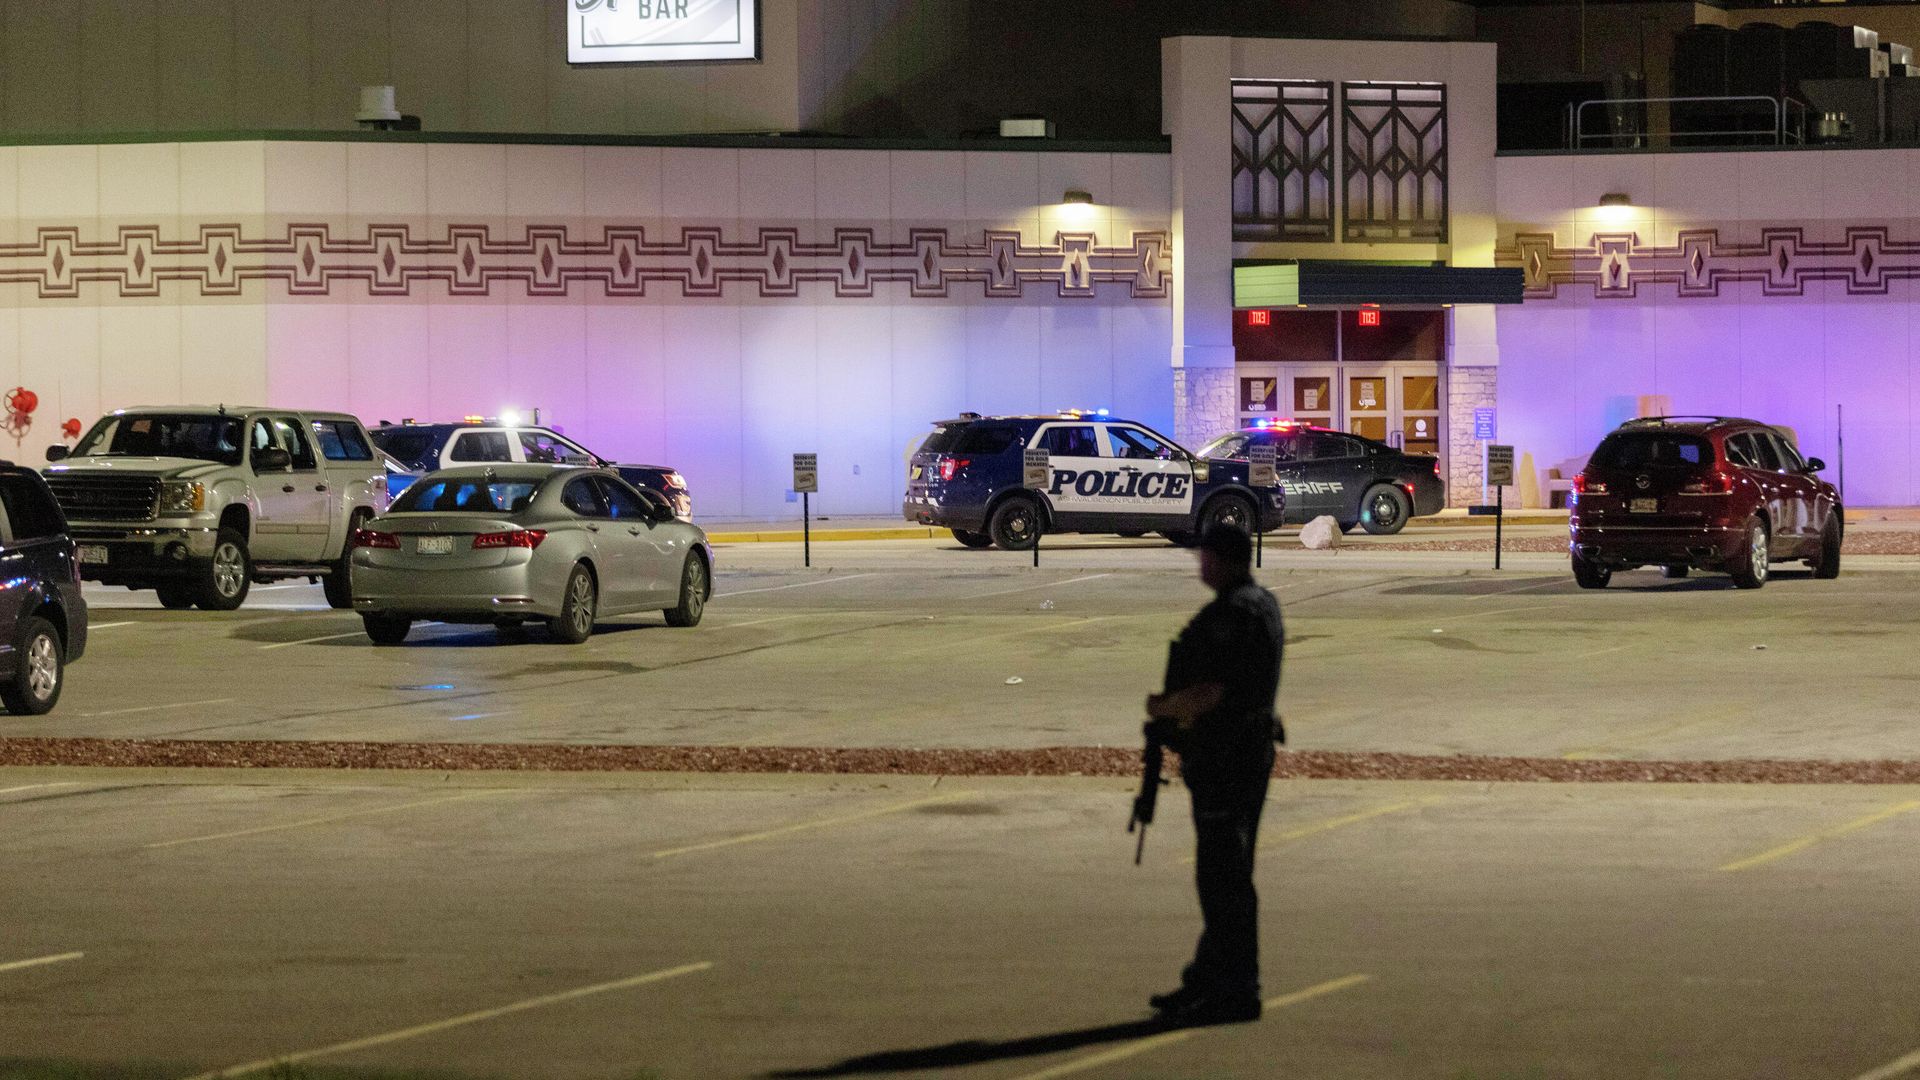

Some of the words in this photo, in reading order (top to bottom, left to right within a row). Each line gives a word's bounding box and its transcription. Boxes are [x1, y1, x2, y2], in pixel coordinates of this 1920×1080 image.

[639, 0, 688, 19] BAR
[1048, 469, 1191, 499] POLICE
[1284, 481, 1344, 495] ERIFF
